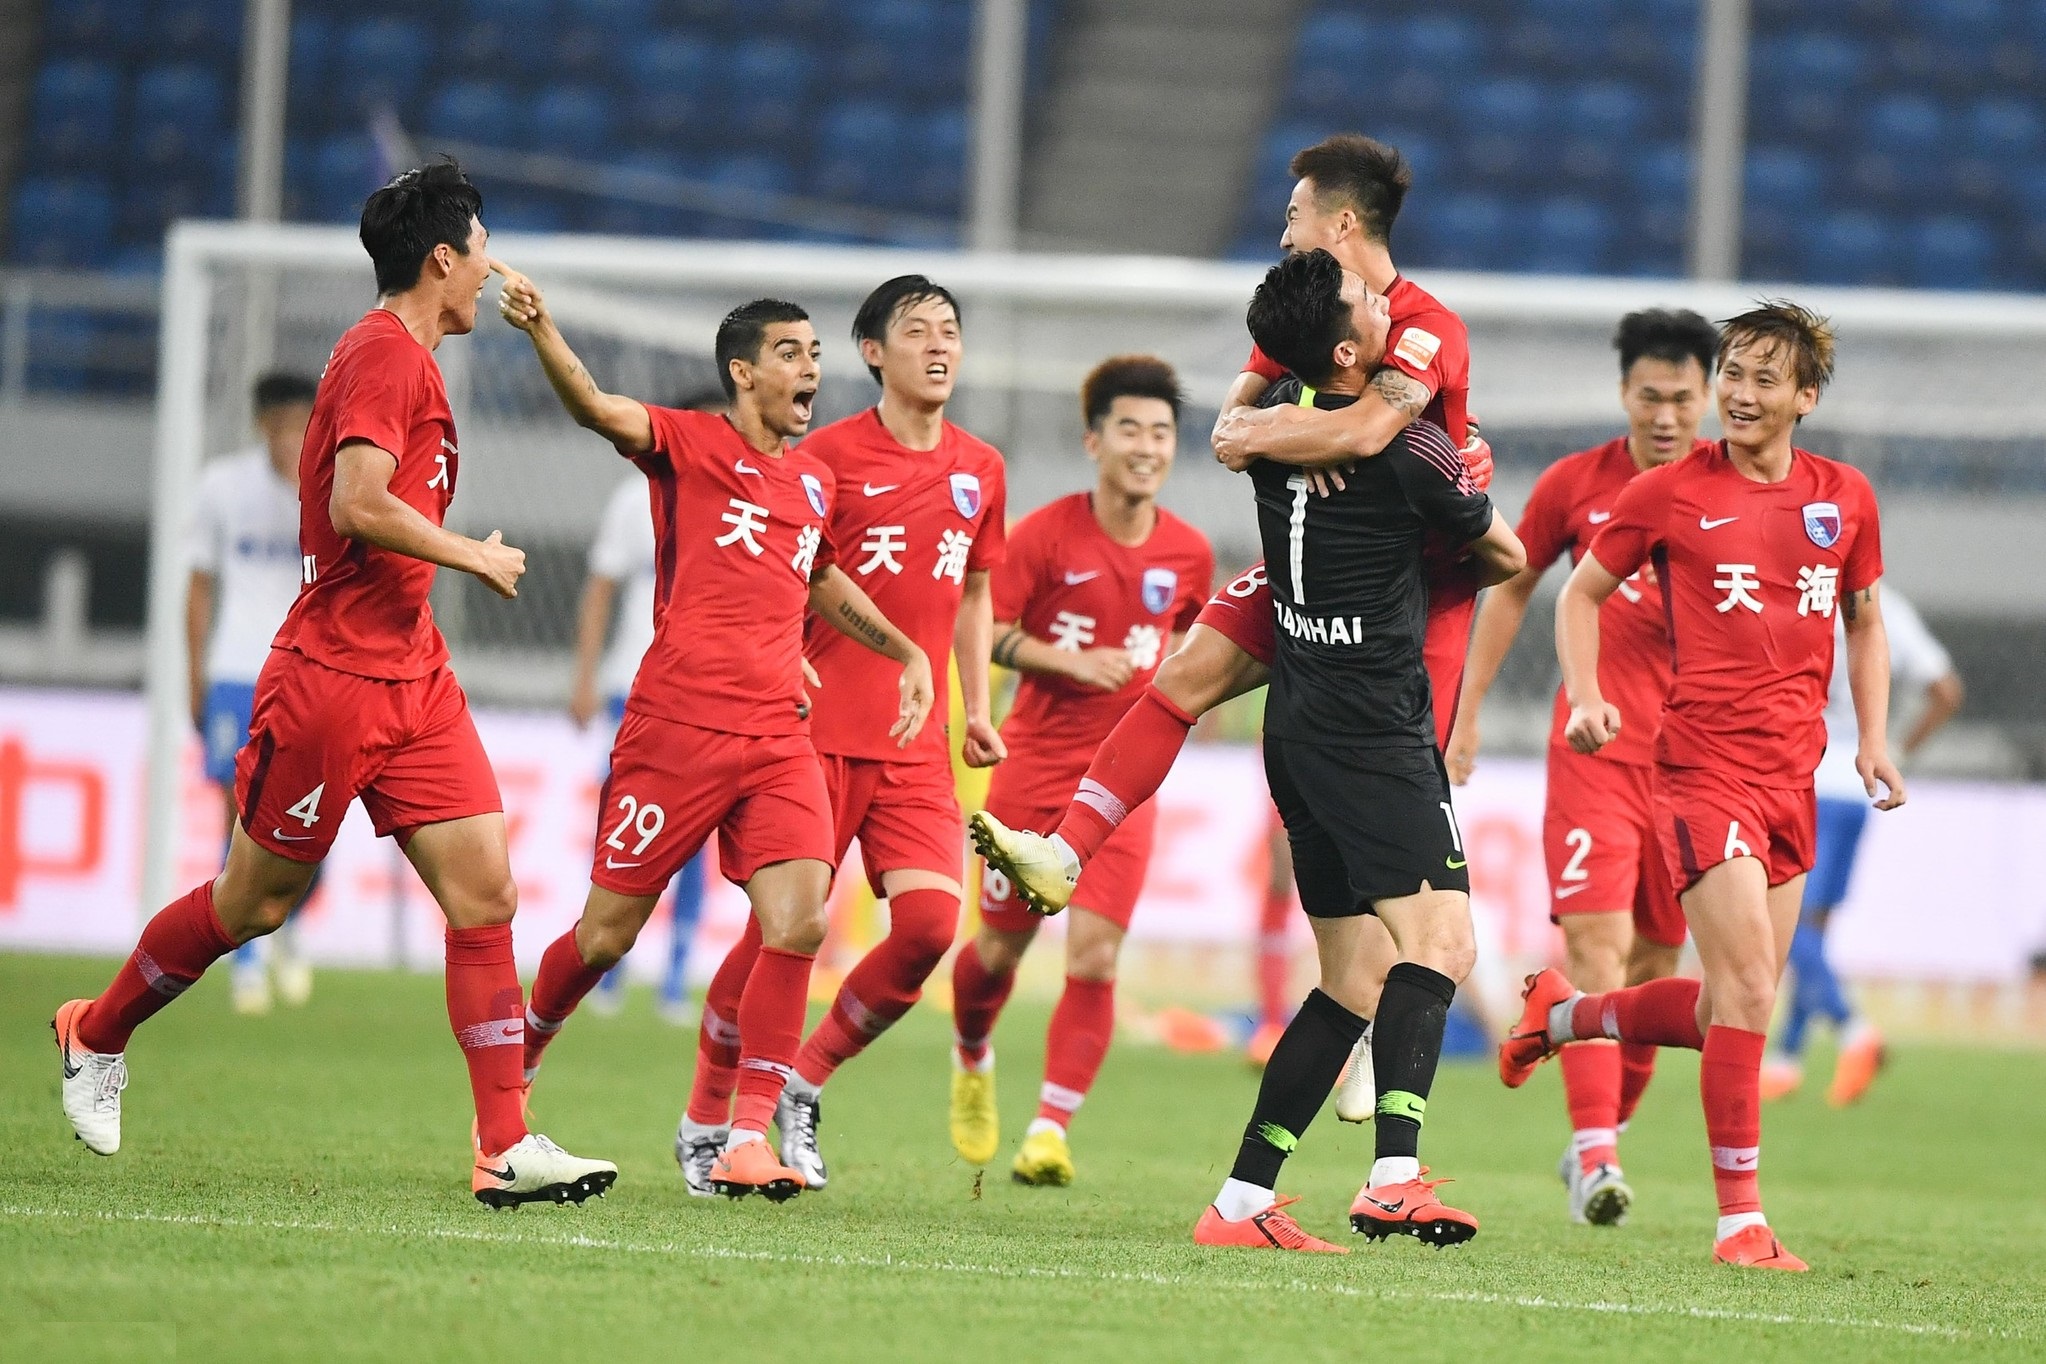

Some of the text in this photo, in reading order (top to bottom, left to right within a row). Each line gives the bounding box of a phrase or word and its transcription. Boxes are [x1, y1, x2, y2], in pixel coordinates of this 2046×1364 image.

[856, 525, 973, 586] 天海
[1286, 473, 1308, 605] 1
[1712, 563, 1839, 618] 天海
[285, 781, 326, 828] 4
[605, 794, 665, 856] 29
[1439, 801, 1461, 852] 1
[1560, 828, 1592, 880] 2
[1724, 820, 1751, 861] 6
